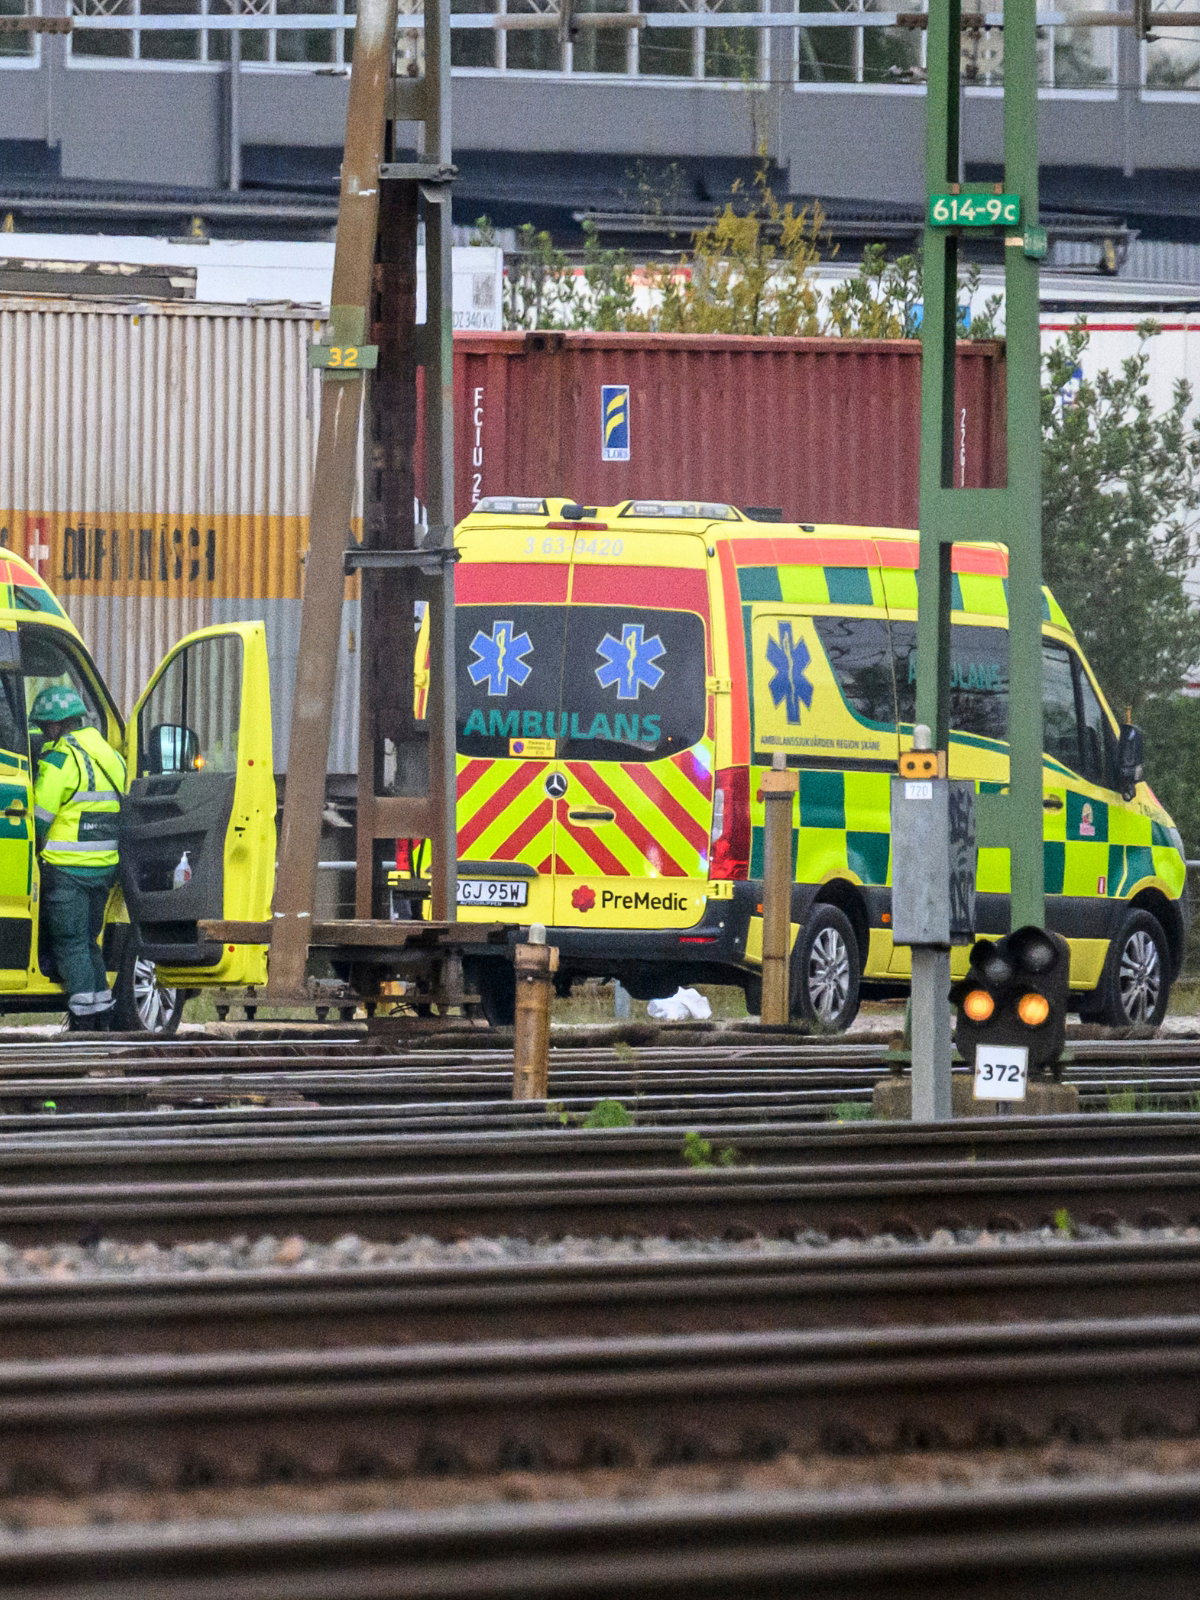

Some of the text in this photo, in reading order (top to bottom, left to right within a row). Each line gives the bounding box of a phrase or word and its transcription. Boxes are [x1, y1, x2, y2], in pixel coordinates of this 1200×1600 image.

[933, 198, 1016, 221] 614-9c
[327, 347, 358, 367] 32
[463, 708, 662, 742] AMBULANS
[487, 883, 520, 901] 95W
[601, 890, 688, 911] PreMedic
[982, 1063, 1020, 1082] 372
